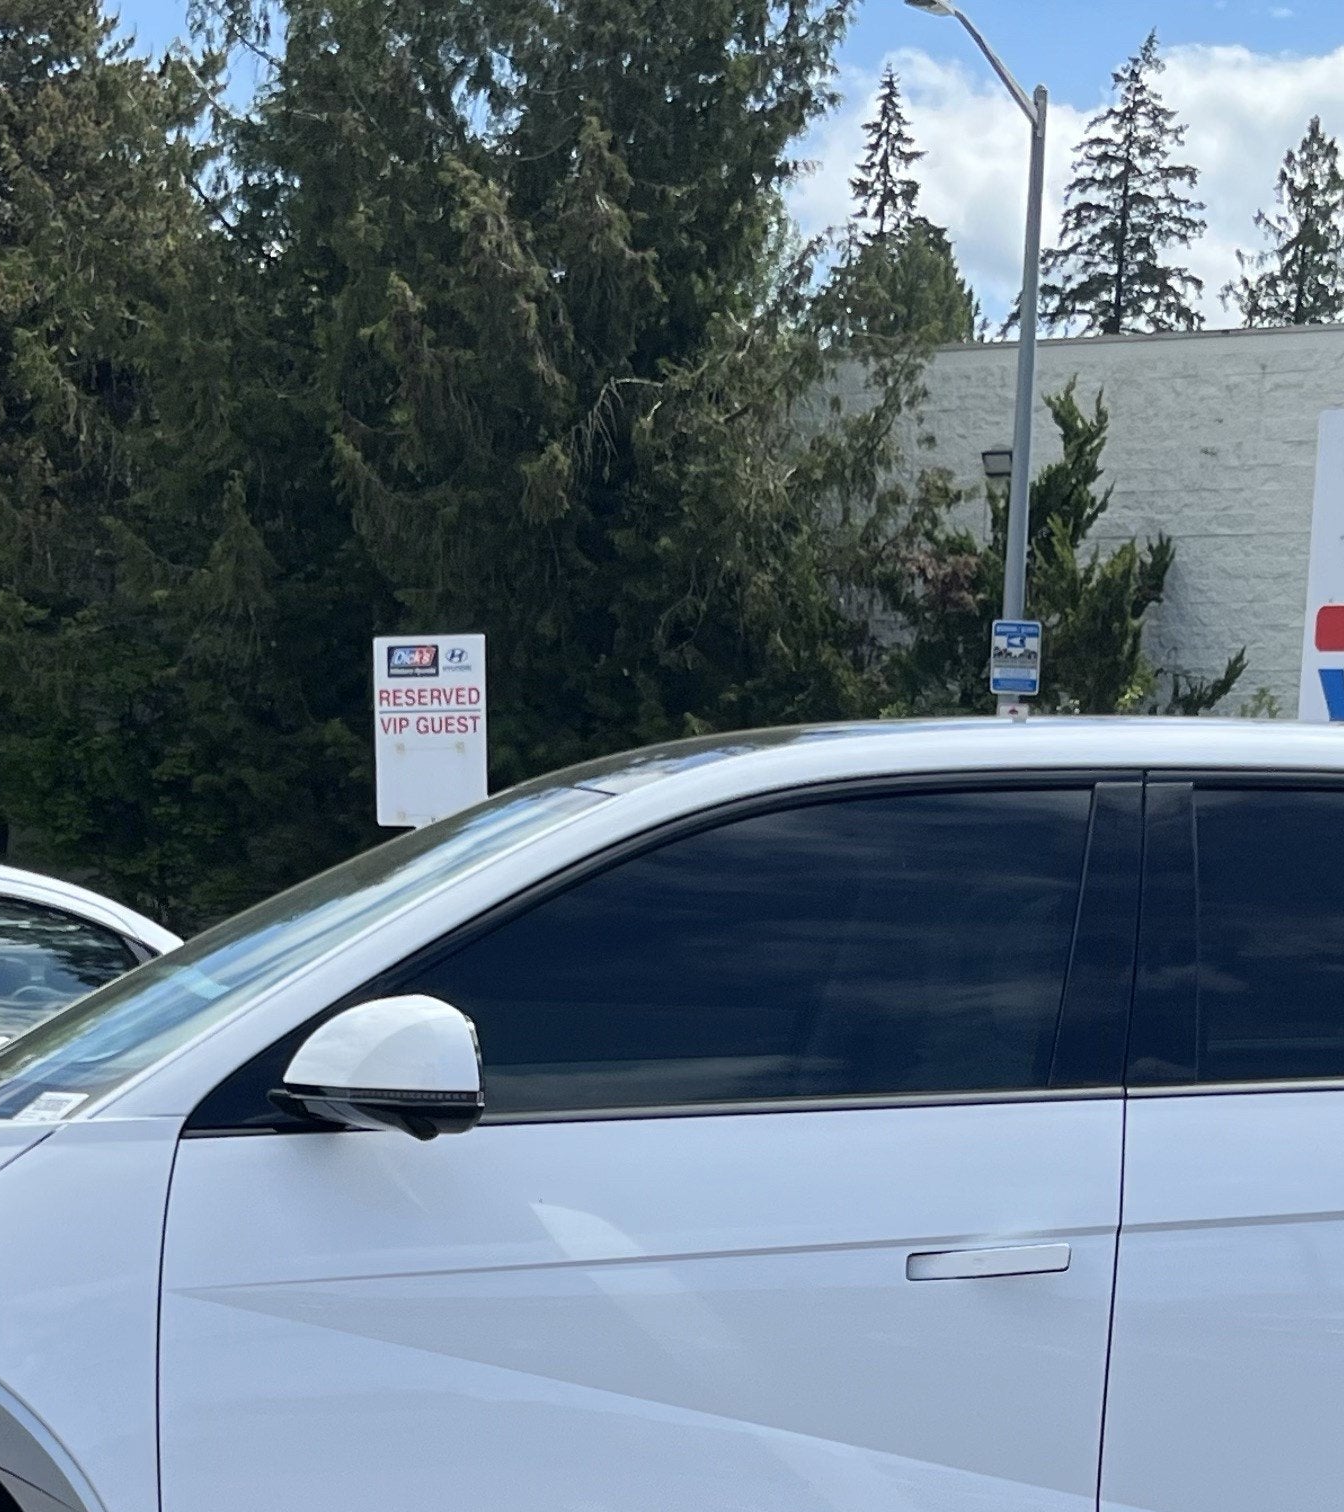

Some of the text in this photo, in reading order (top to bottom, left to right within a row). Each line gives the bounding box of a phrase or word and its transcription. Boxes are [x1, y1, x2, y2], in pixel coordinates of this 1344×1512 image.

[379, 687, 481, 707] RESERVED
[380, 715, 481, 734] VIP GUEST
